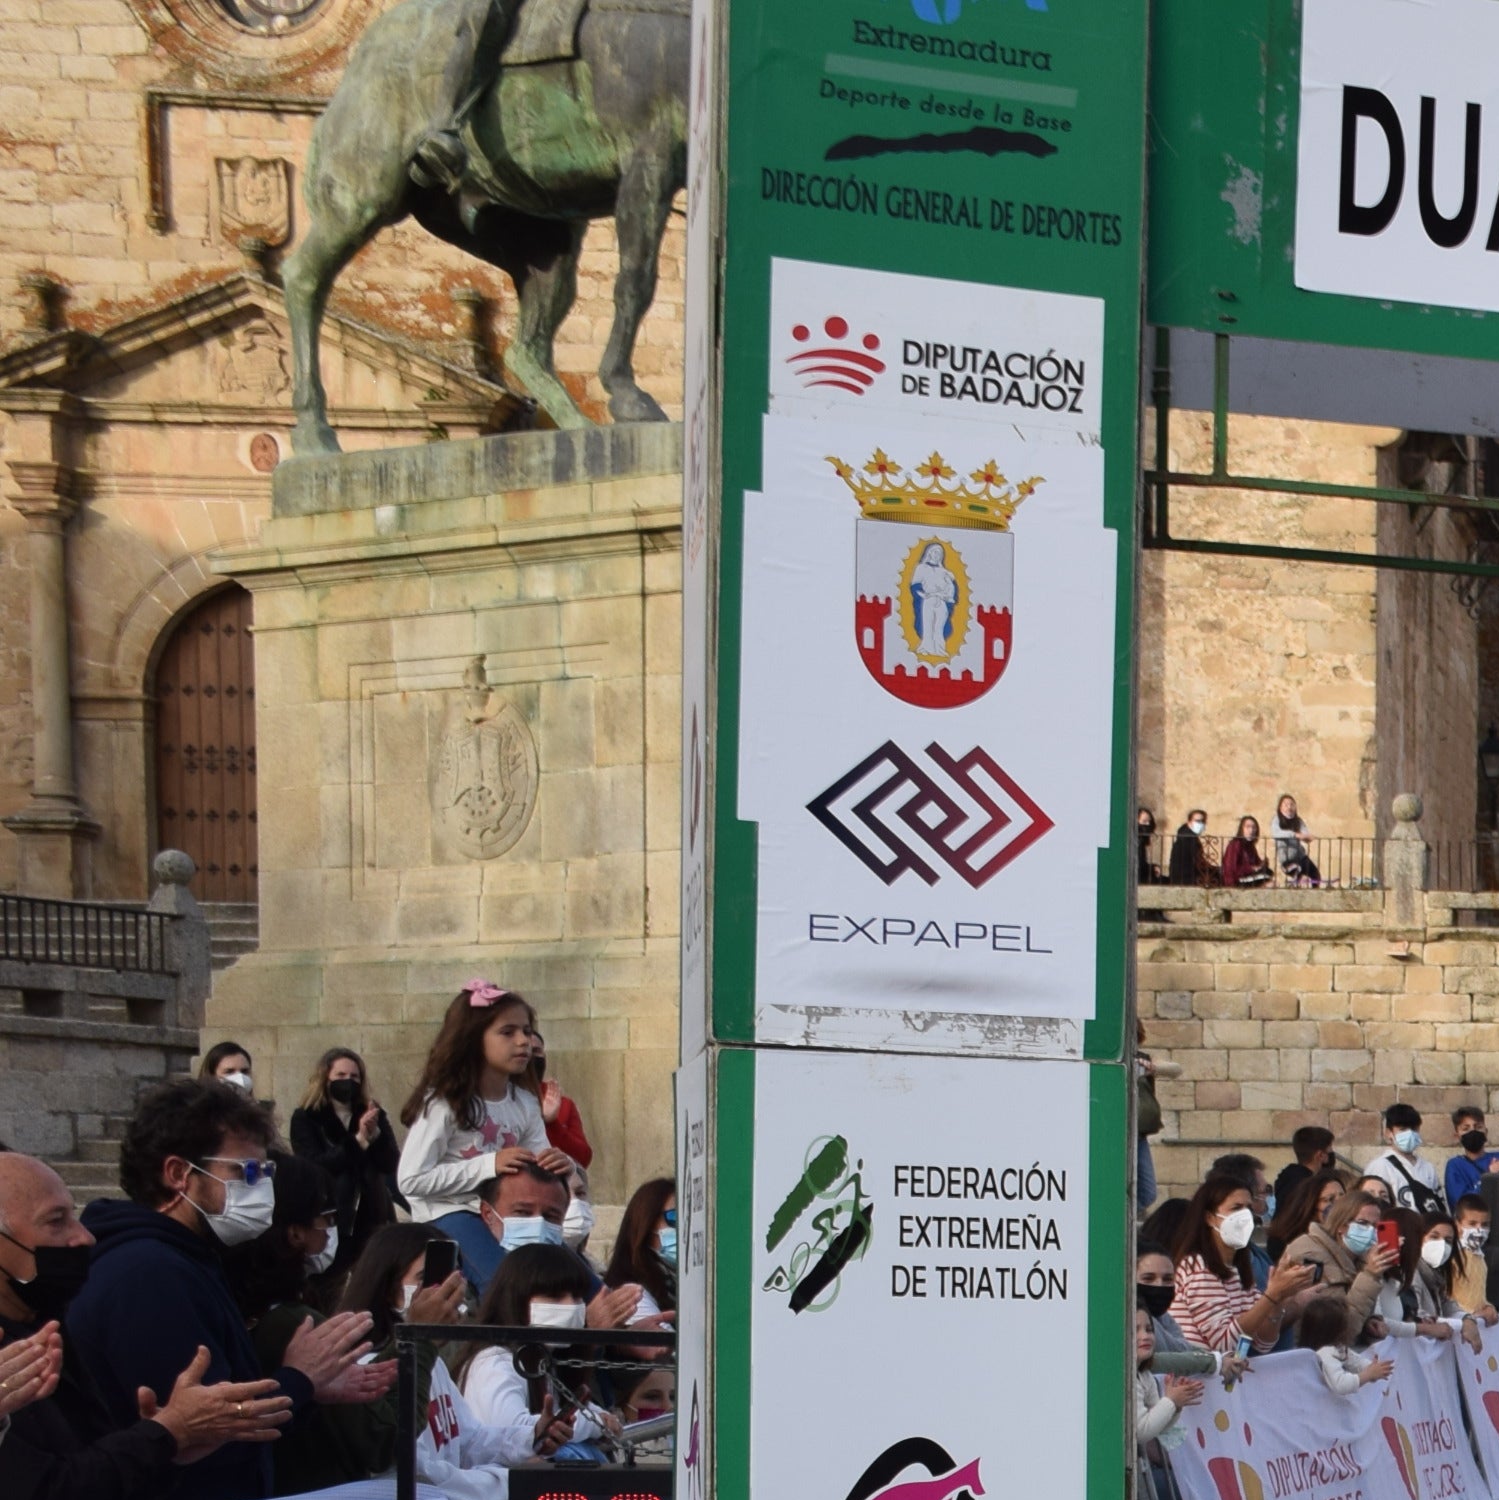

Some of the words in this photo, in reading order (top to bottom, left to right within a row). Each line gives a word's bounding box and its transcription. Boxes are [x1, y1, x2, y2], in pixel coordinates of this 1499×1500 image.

[852, 19, 1053, 72] Extremadura
[819, 79, 911, 112] Deporte
[920, 93, 985, 122] desde
[994, 103, 1014, 125] la
[1023, 108, 1073, 134] Base
[761, 166, 879, 217] DIRECCIÓN
[885, 185, 982, 229] GENERAL
[990, 199, 1015, 234] DE
[1022, 204, 1122, 247] DEPORTES
[902, 340, 1086, 387] DIPUTACIÓN
[901, 374, 931, 396] DE
[939, 378, 1084, 414] BADAJOZ
[808, 913, 1054, 954] EXPAPEL
[893, 1160, 1067, 1202] FEDERACIÓN
[898, 1212, 1062, 1251] EXTREMEÑA
[890, 1264, 927, 1298] DE
[935, 1260, 1069, 1301] TRIATLÓN
[1266, 1437, 1363, 1499] DIPUTACIÓN
